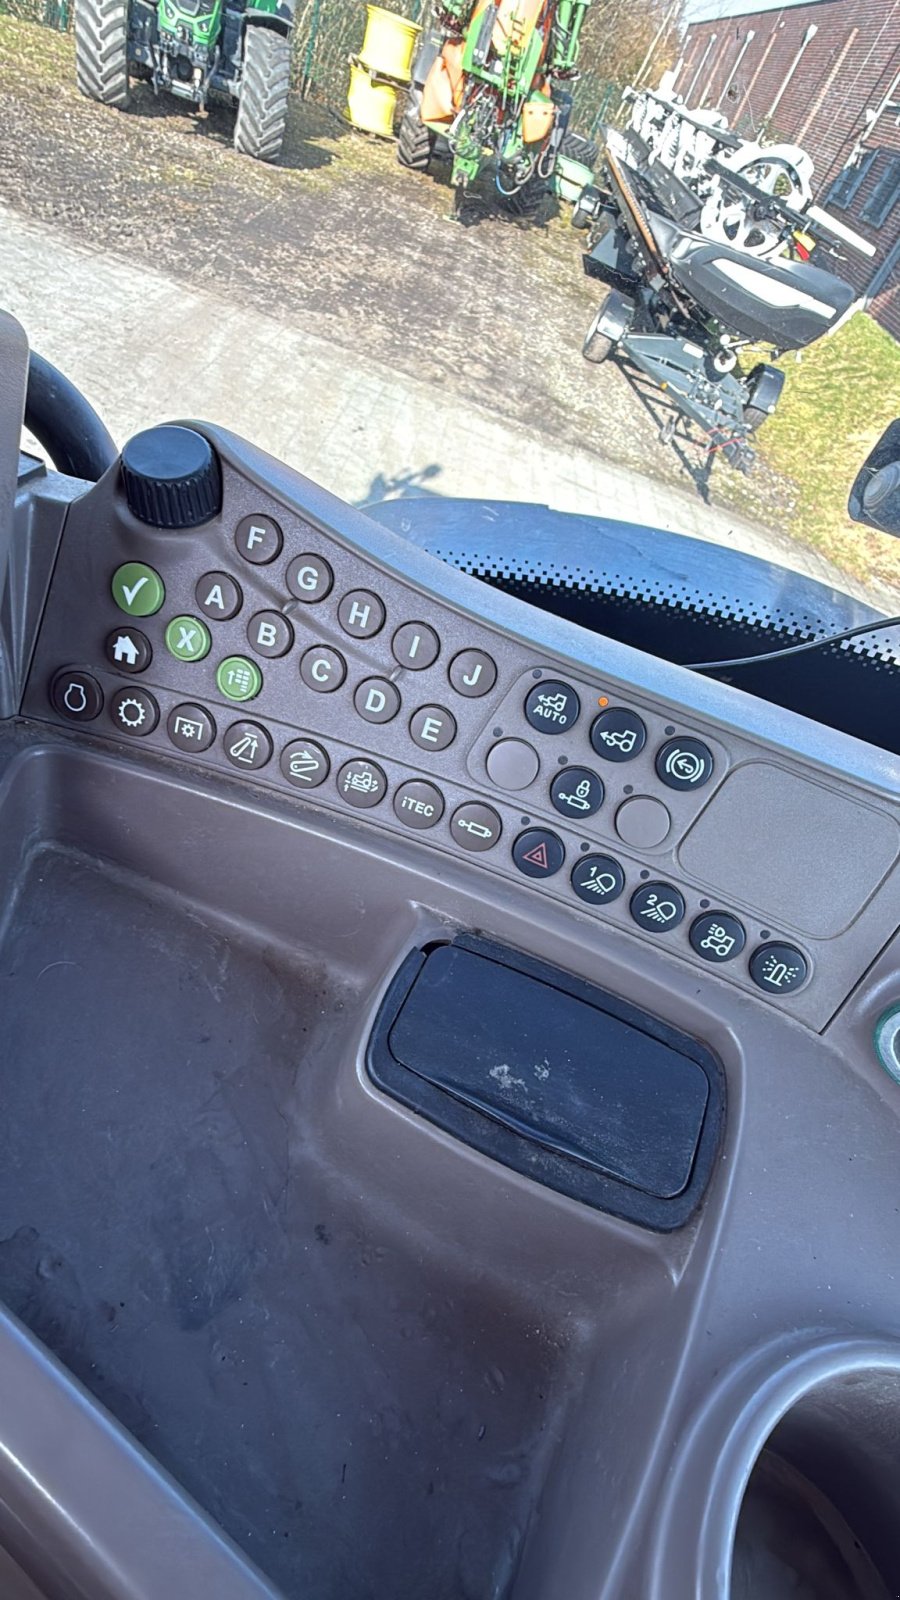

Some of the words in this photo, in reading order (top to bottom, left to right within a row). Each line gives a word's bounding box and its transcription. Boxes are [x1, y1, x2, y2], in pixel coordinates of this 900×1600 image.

[247, 526, 266, 549] F
[297, 566, 319, 591] G
[204, 584, 225, 610] A
[348, 601, 371, 628] H
[257, 621, 277, 647] B
[409, 635, 420, 658] I
[311, 659, 332, 682] C
[462, 664, 482, 686] J
[364, 689, 386, 713] D
[532, 704, 568, 725] AUTO
[420, 717, 443, 743] E
[401, 795, 435, 818] iTEC
[589, 866, 598, 877] 1
[646, 893, 658, 906] 2
